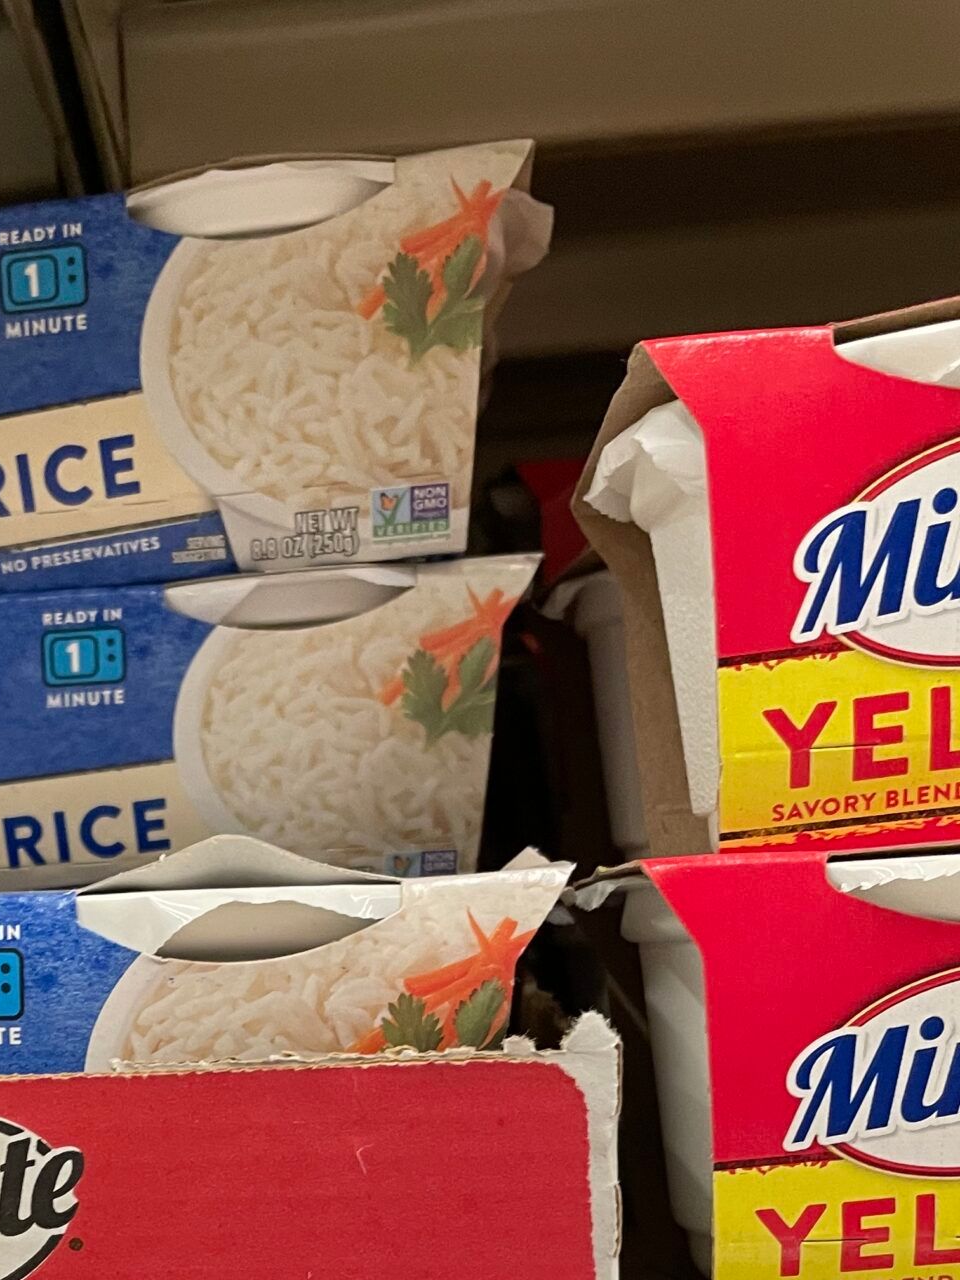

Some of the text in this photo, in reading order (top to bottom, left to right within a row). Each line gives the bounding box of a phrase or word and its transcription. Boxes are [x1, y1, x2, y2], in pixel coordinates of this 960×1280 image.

[55, 223, 83, 241] IN
[22, 262, 42, 298] 1
[5, 314, 88, 339] MINUTE
[294, 507, 360, 533] NET WT
[1, 556, 27, 574] NO
[31, 537, 161, 569] PRESERVATIVES
[282, 535, 307, 559] OZ
[42, 609, 122, 626] READY IN
[65, 641, 81, 674] 1
[46, 688, 125, 709] MINUTE
[772, 793, 877, 822] SAVORY
[2, 799, 171, 870] RICE
